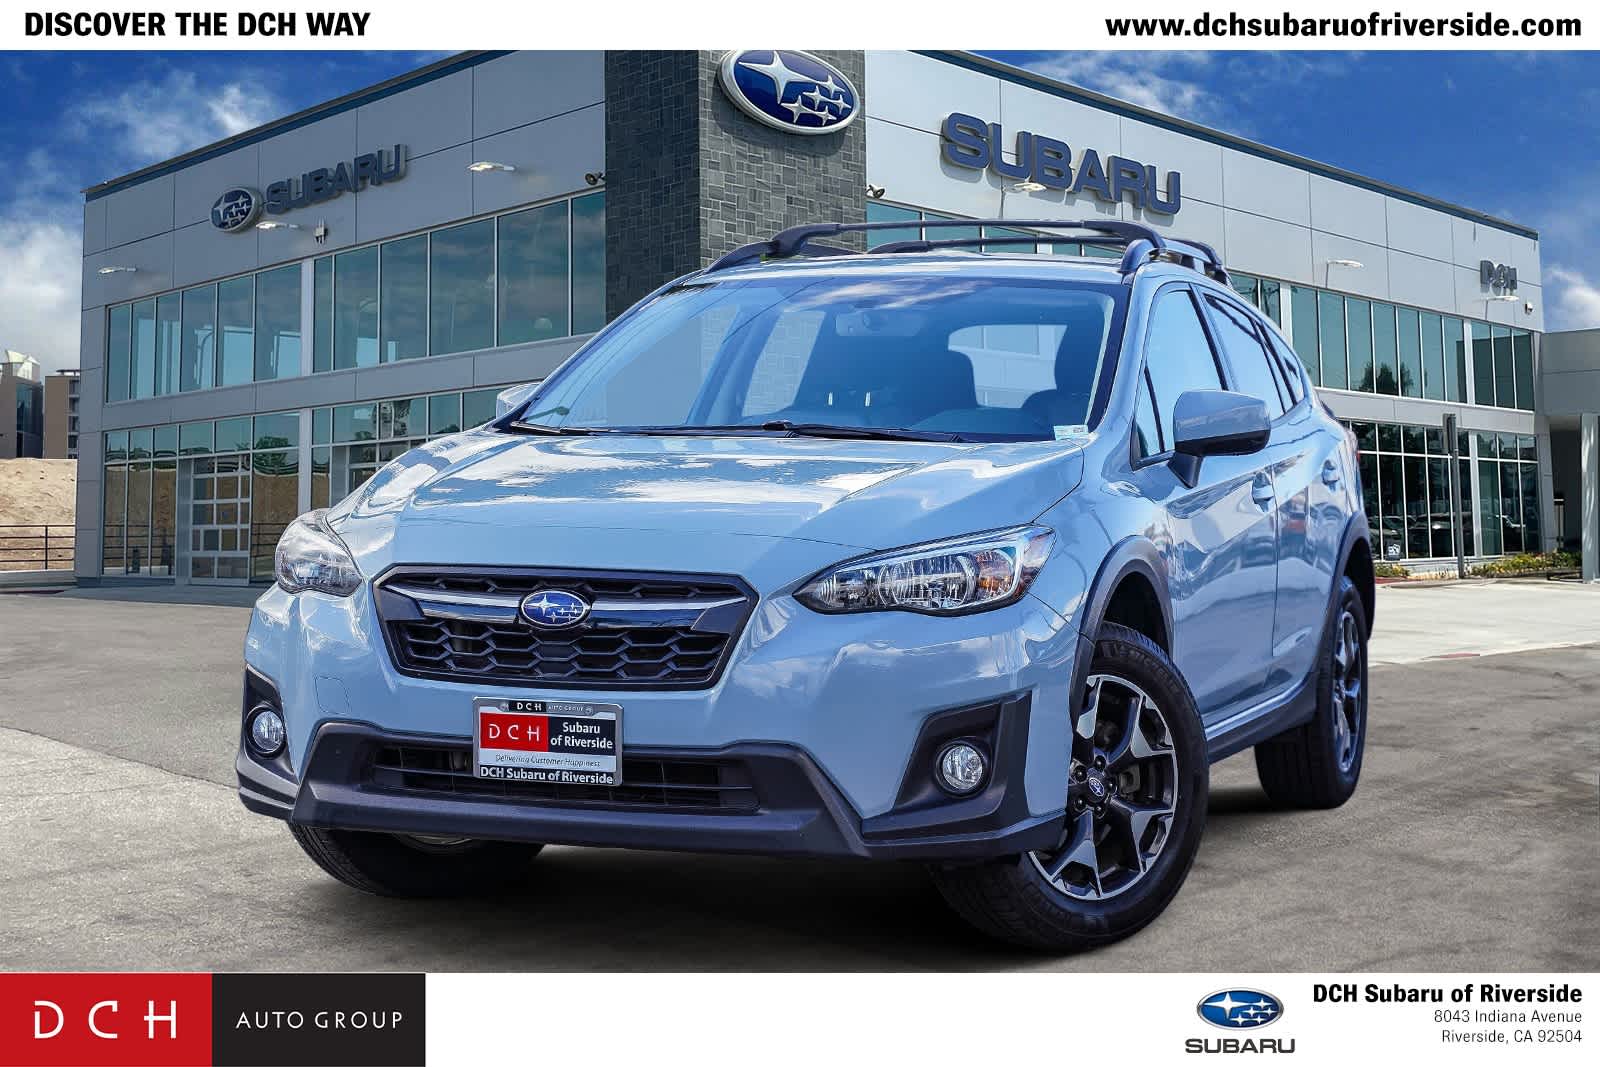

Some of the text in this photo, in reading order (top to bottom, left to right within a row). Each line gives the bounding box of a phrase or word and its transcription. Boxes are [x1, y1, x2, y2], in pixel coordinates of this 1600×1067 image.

[942, 112, 1181, 215] SUBARU
[266, 144, 407, 215] SUBARU
[516, 702, 542, 711] DCH
[488, 723, 540, 742] DCH
[563, 722, 600, 734] Subaru
[550, 736, 613, 749] of Riverside
[496, 754, 600, 769] Delivering Customer Happiness
[480, 766, 613, 784] DCH Subaru of Riverside
